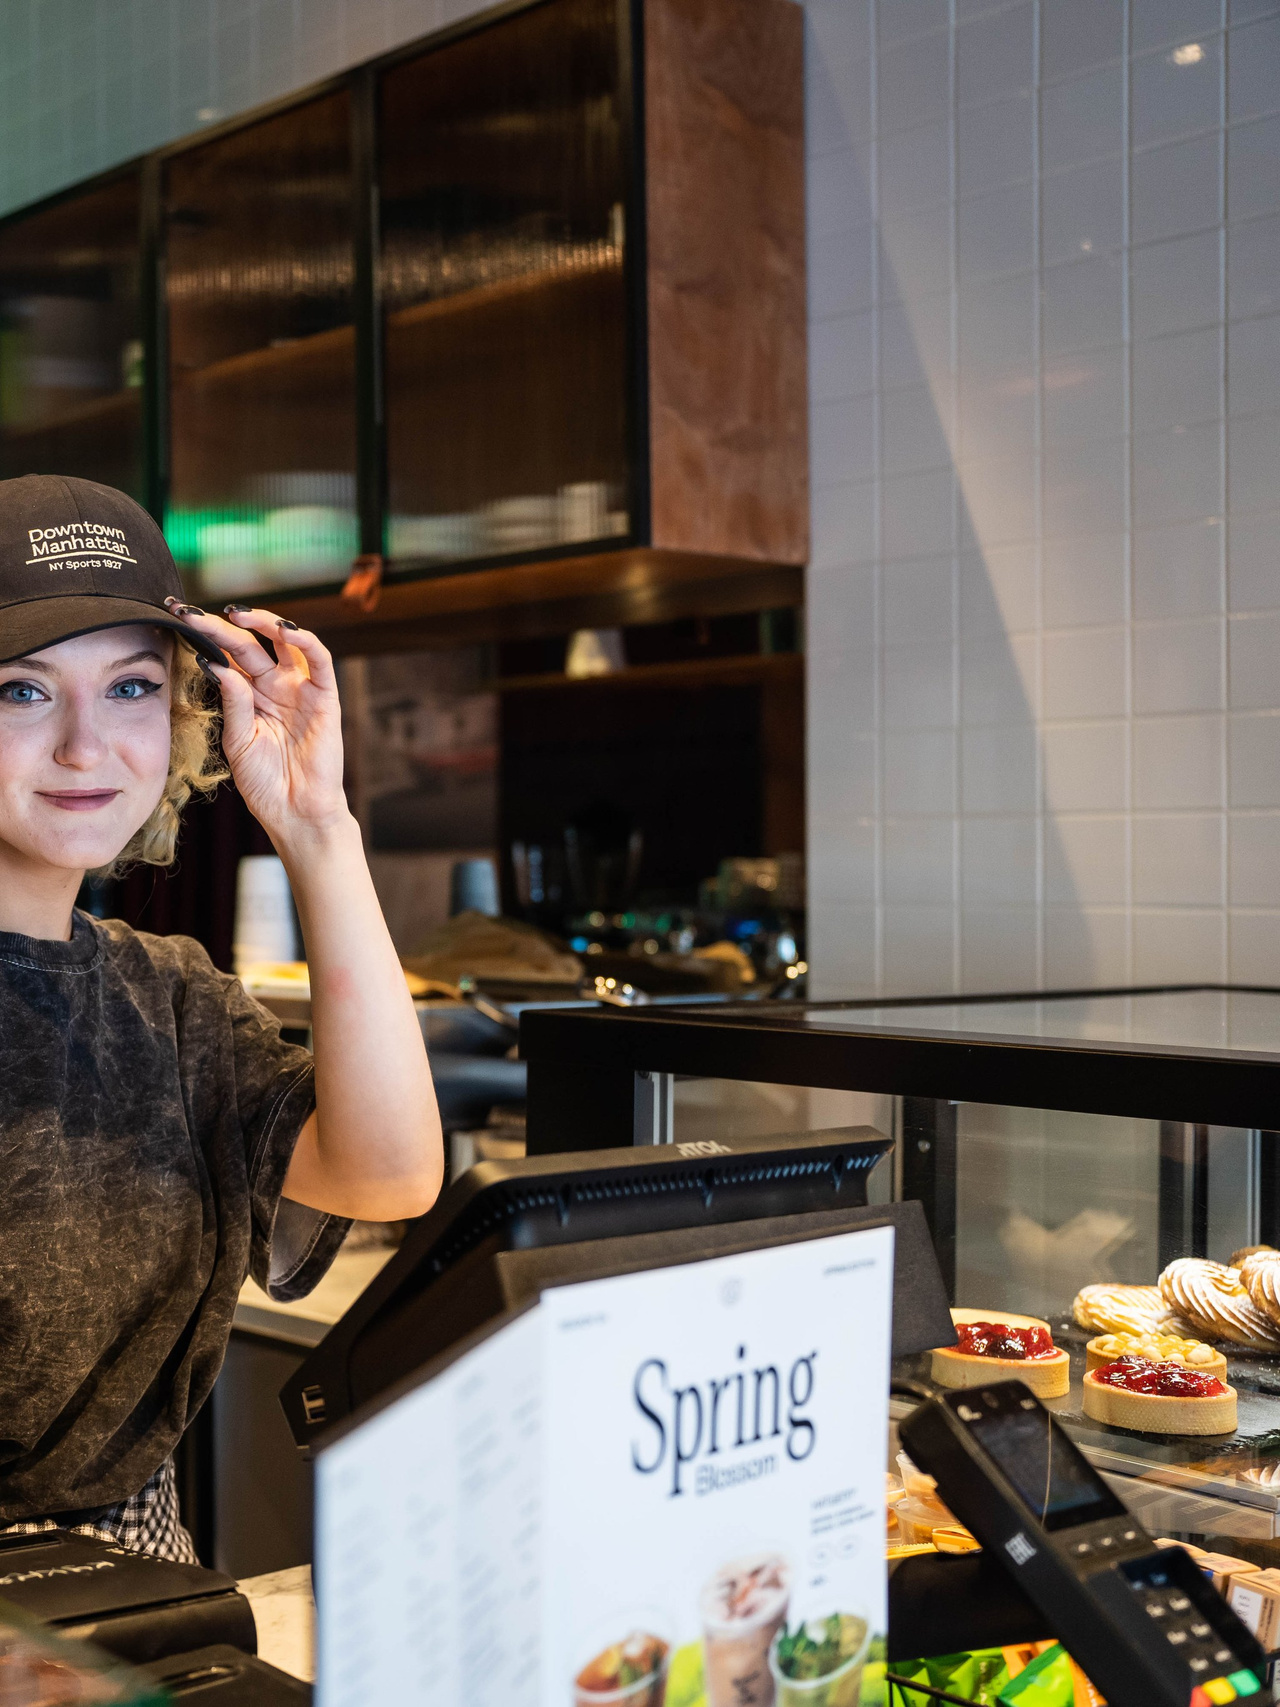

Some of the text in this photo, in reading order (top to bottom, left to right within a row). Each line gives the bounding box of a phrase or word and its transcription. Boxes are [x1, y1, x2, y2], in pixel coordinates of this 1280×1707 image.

[28, 521, 126, 543] Downtown
[31, 535, 131, 557] Manhattan
[49, 561, 64, 571] NY
[65, 559, 101, 571] Sports
[630, 1345, 817, 1497] Spring
